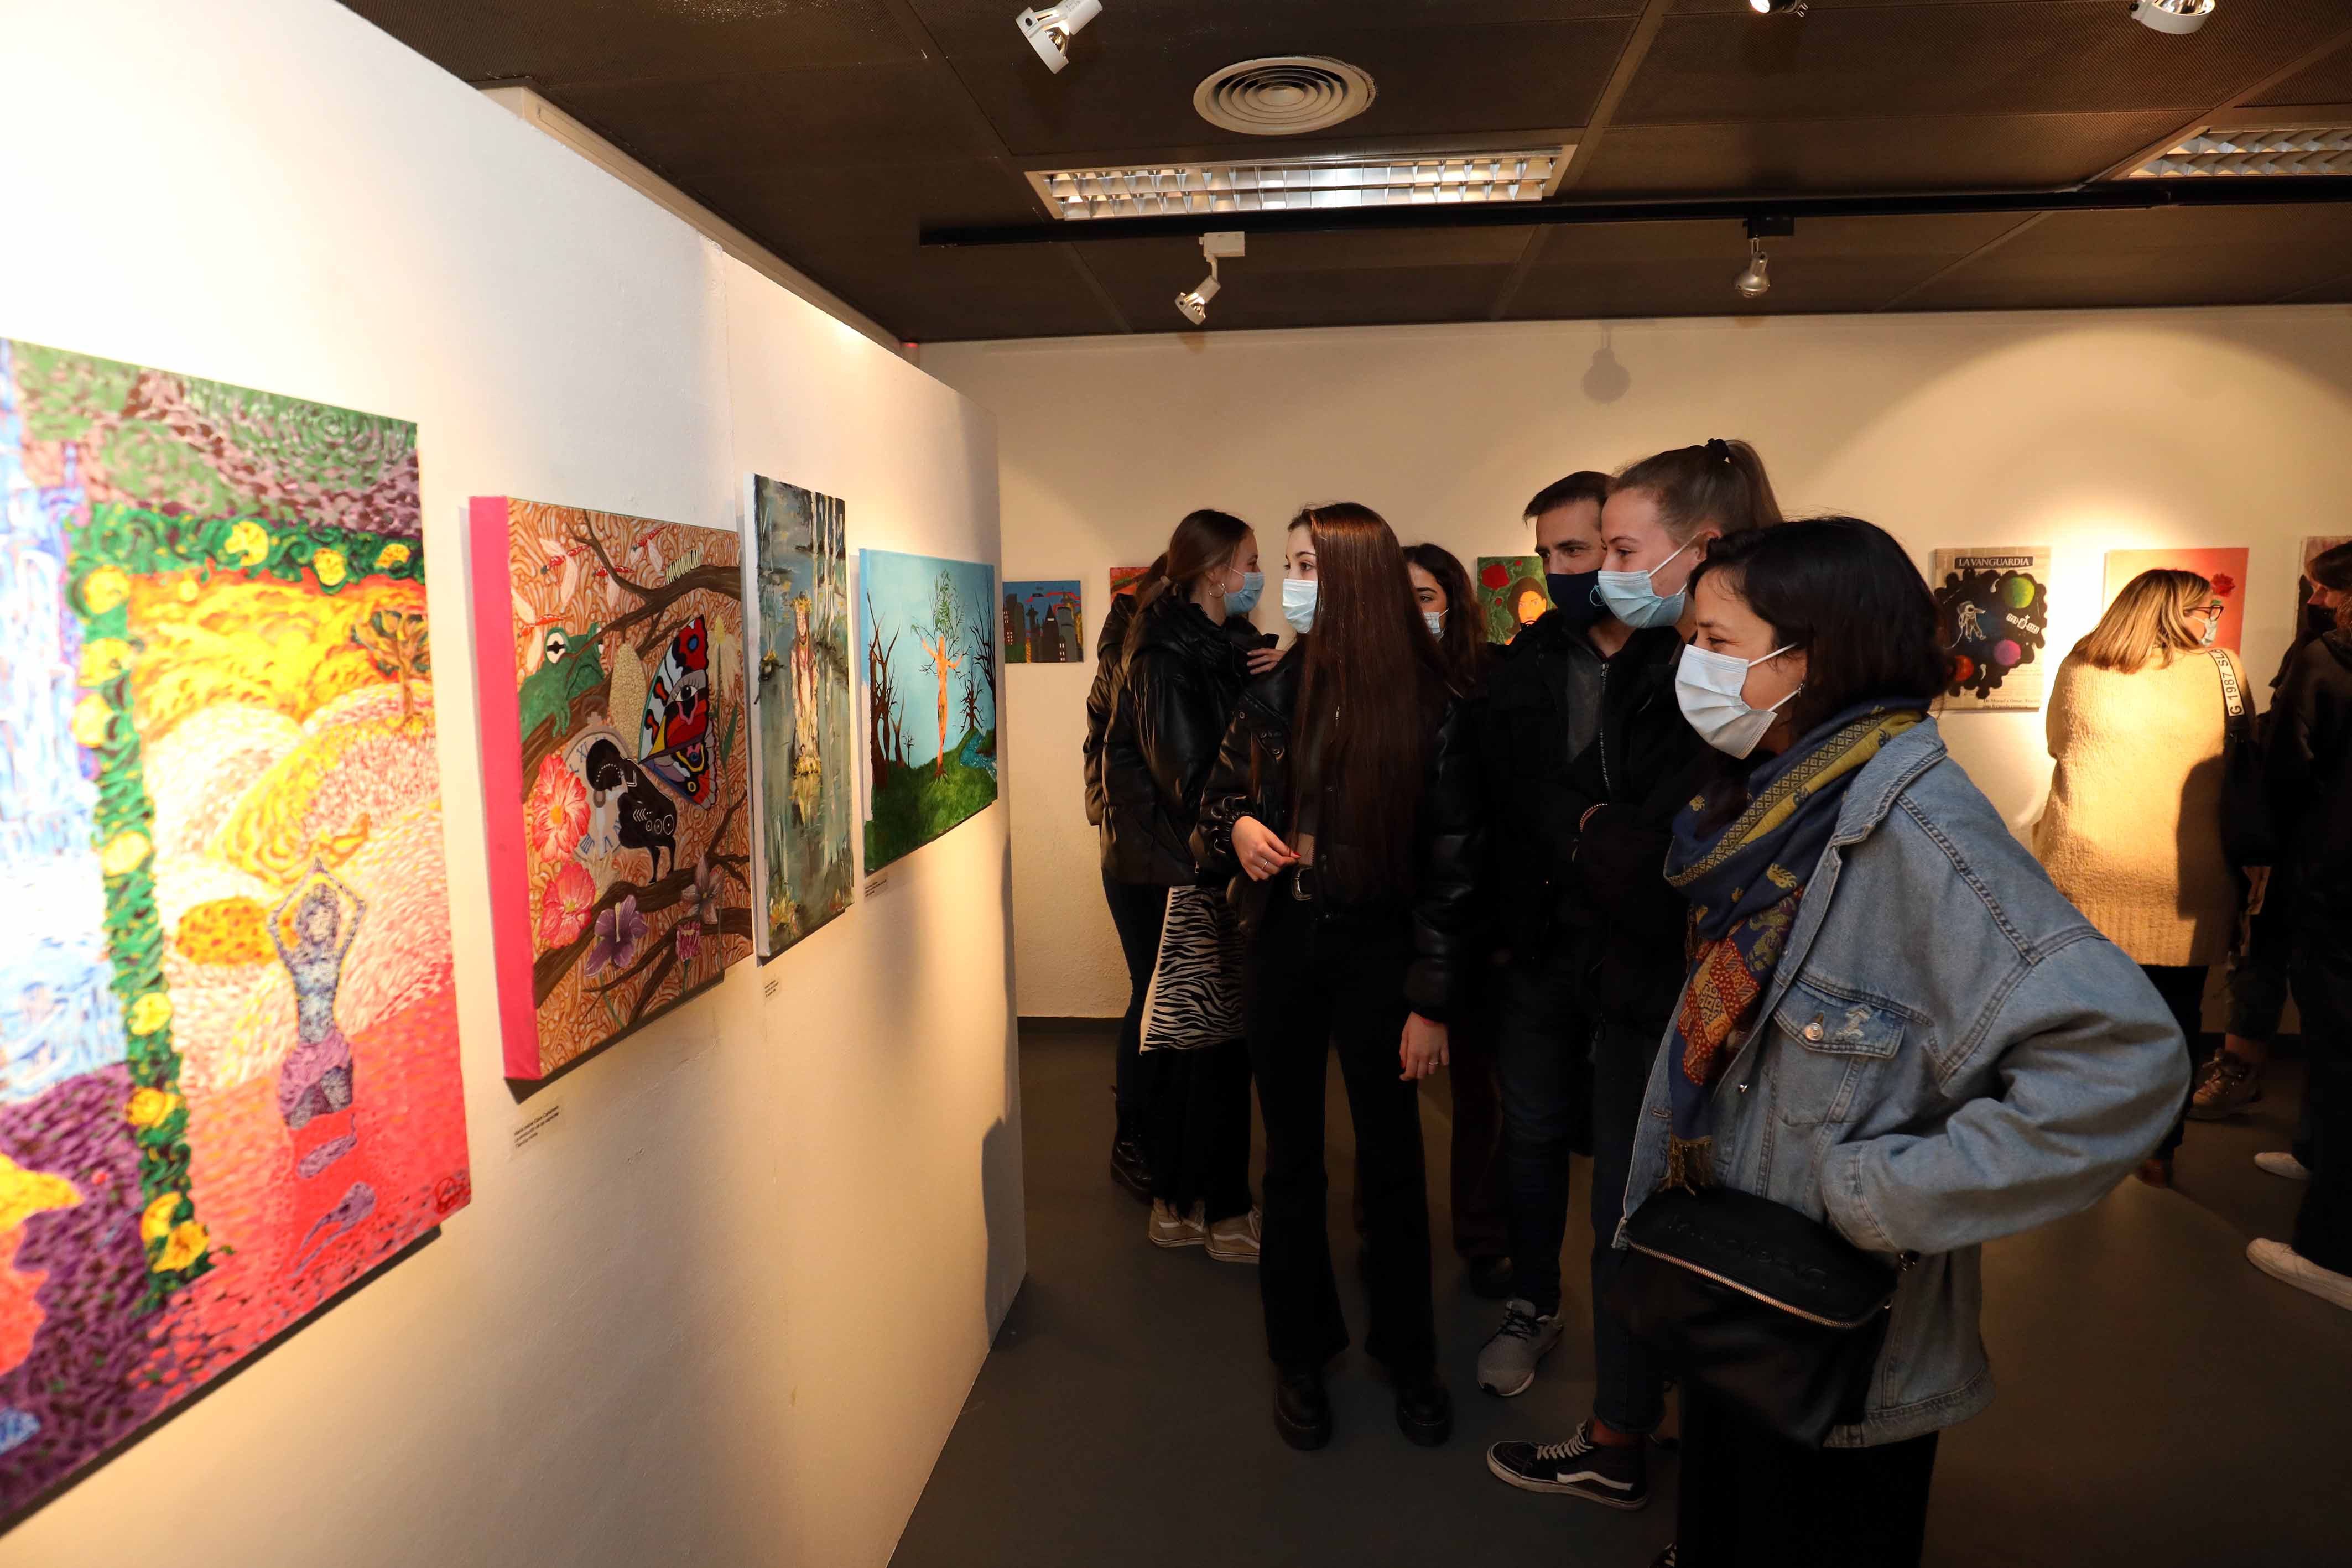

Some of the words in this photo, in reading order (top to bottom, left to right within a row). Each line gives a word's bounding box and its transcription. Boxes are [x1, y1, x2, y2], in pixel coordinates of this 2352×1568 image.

[1959, 558, 1970, 566] LA
[1970, 558, 2030, 566] VANGUARDIA
[2223, 672, 2238, 700] 1987
